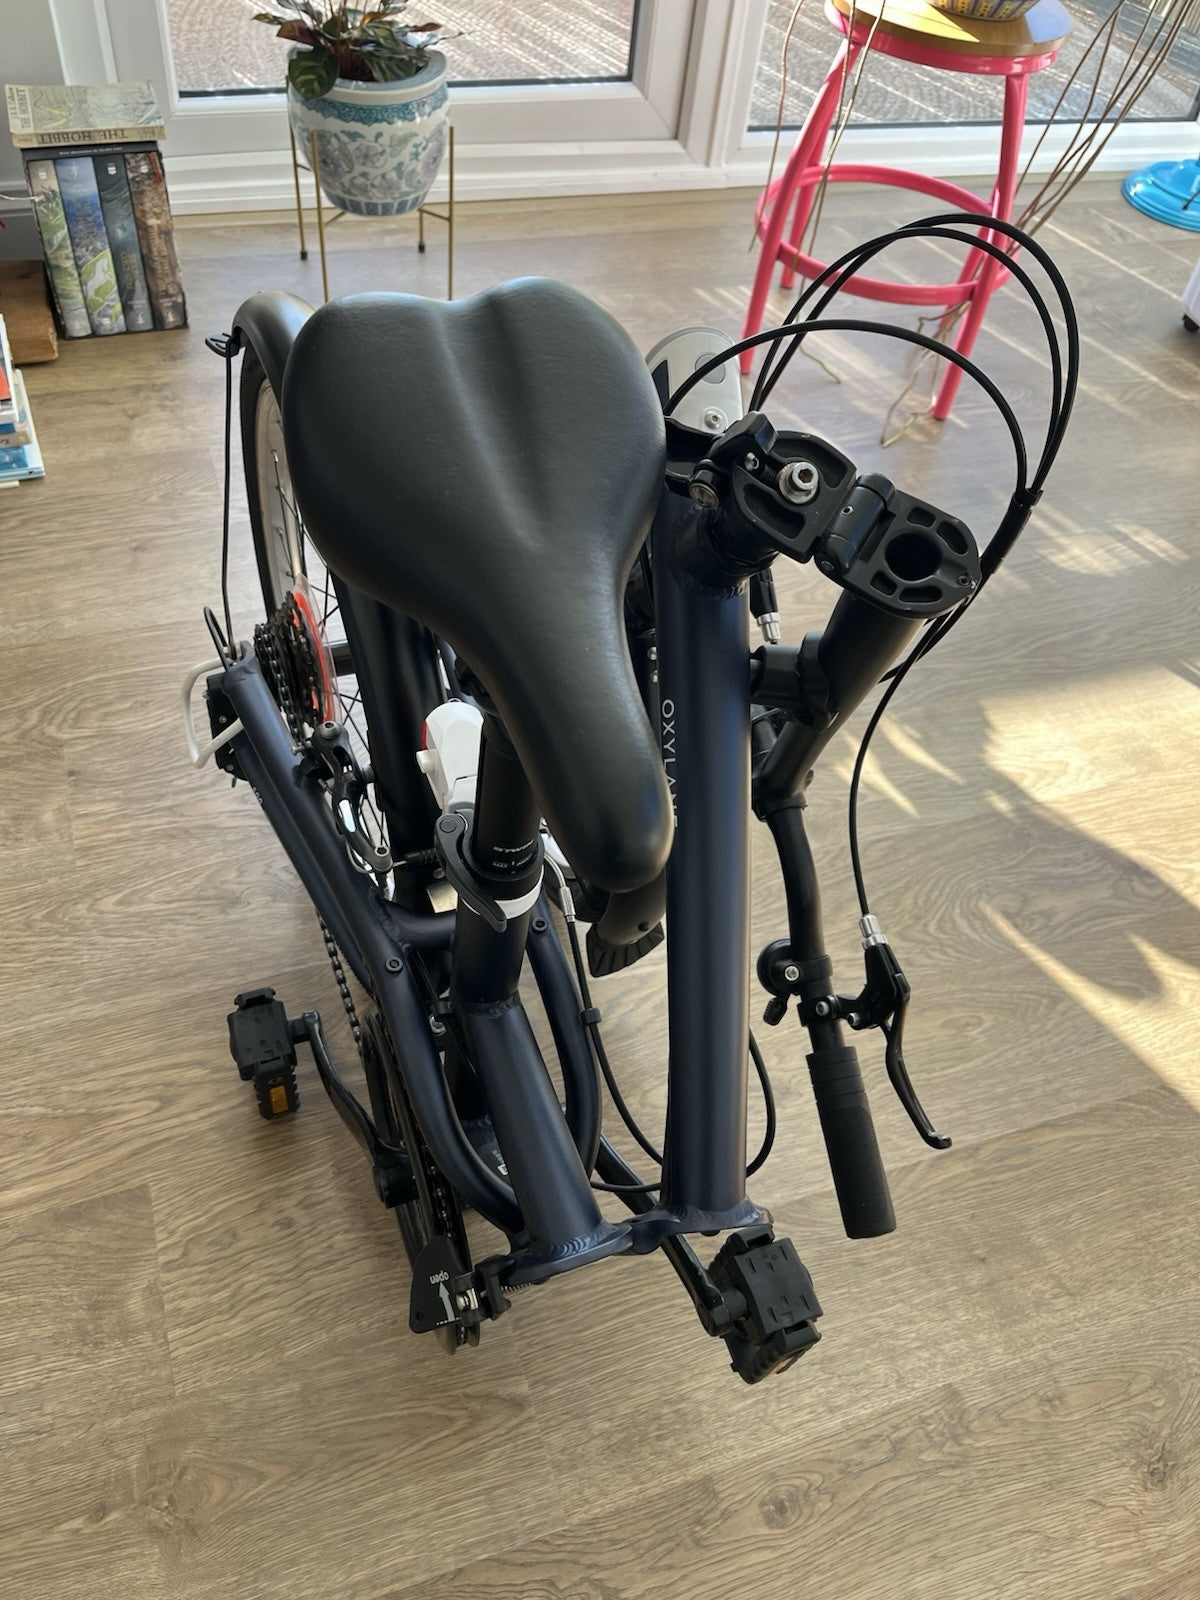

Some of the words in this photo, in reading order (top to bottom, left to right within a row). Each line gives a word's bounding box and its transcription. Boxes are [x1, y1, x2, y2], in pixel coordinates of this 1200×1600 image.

[15, 88, 29, 115] HOBBIT
[39, 130, 91, 144] HOBBIT
[103, 128, 129, 140] THE
[662, 699, 678, 828] OXYLA
[429, 1270, 449, 1284] open
